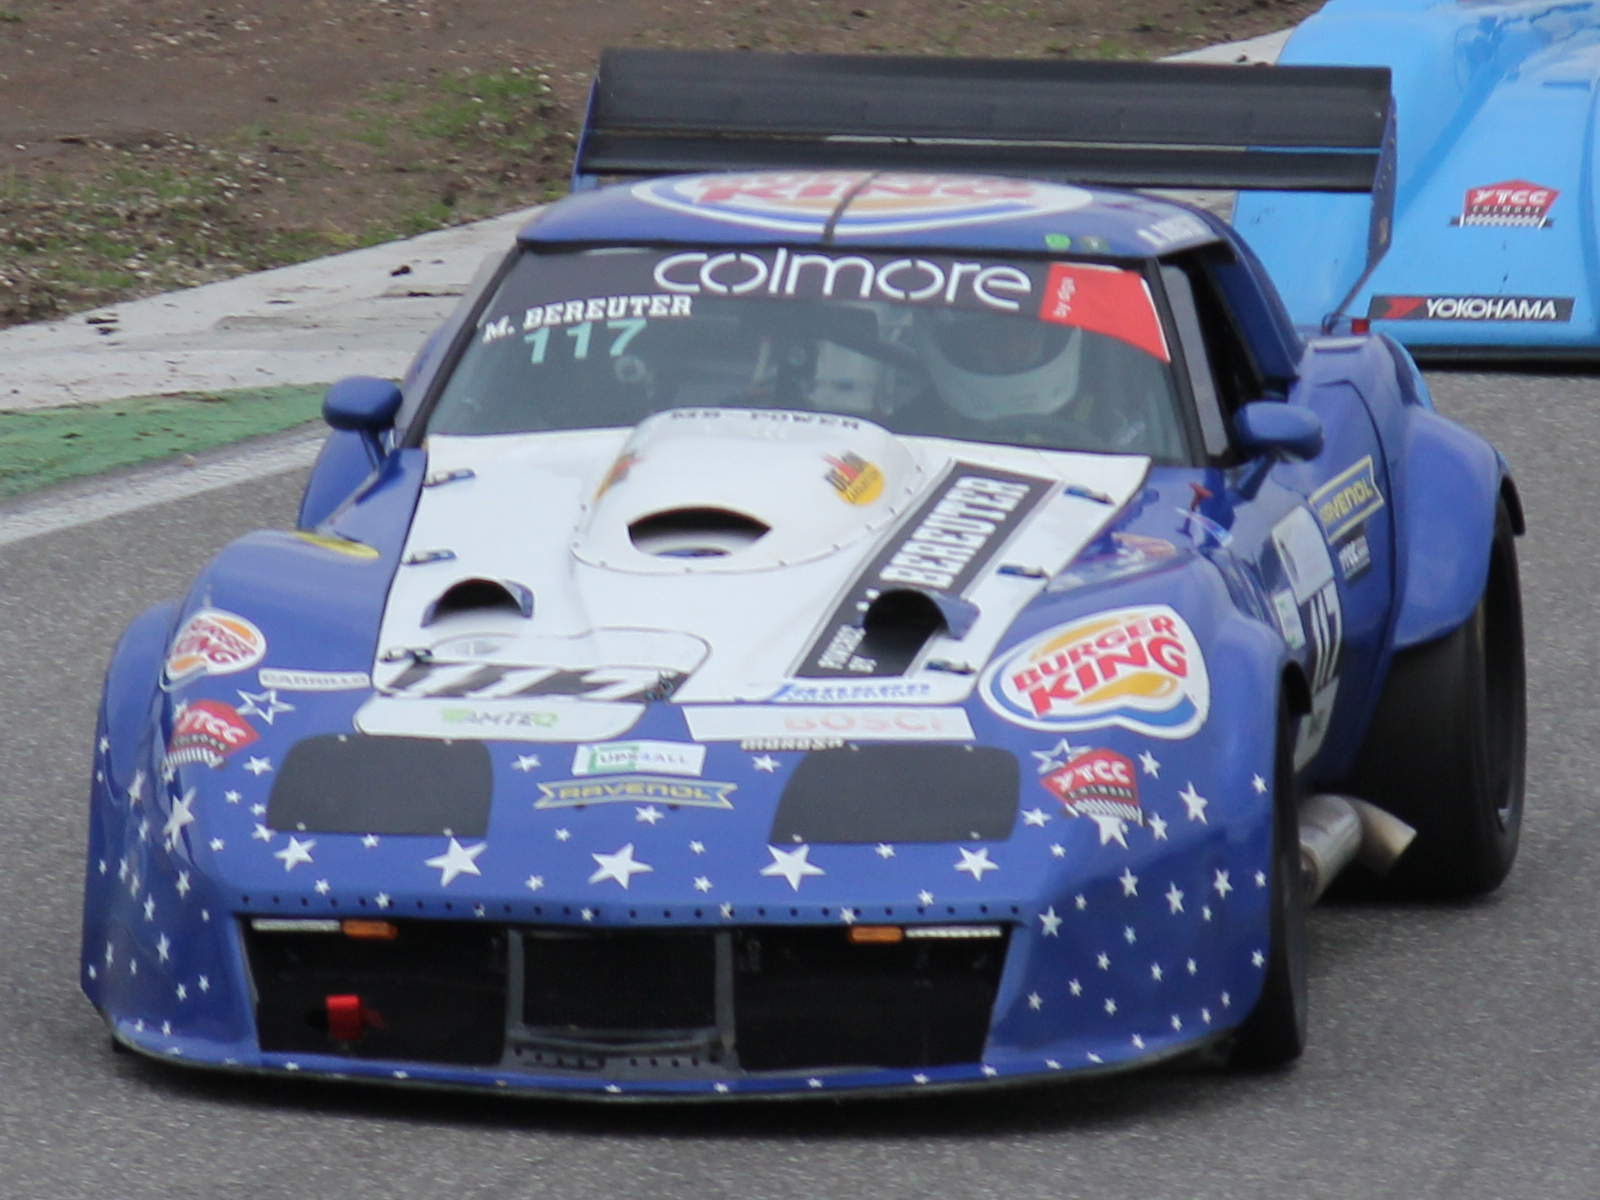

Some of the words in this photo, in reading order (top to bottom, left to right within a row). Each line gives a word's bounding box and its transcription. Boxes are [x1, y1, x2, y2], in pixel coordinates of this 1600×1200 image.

[1473, 189, 1549, 205] YTCC
[653, 247, 1033, 311] colmore
[483, 315, 516, 344] M.
[523, 294, 693, 330] BEREUTER
[1426, 298, 1557, 319] YOKOHAMA
[524, 317, 648, 365] 117
[878, 475, 1031, 590] BEREUTER
[1012, 615, 1179, 693] BURGER
[1029, 636, 1188, 717] KING
[558, 781, 713, 801] RAVENOL
[1052, 758, 1131, 793] YTCC
